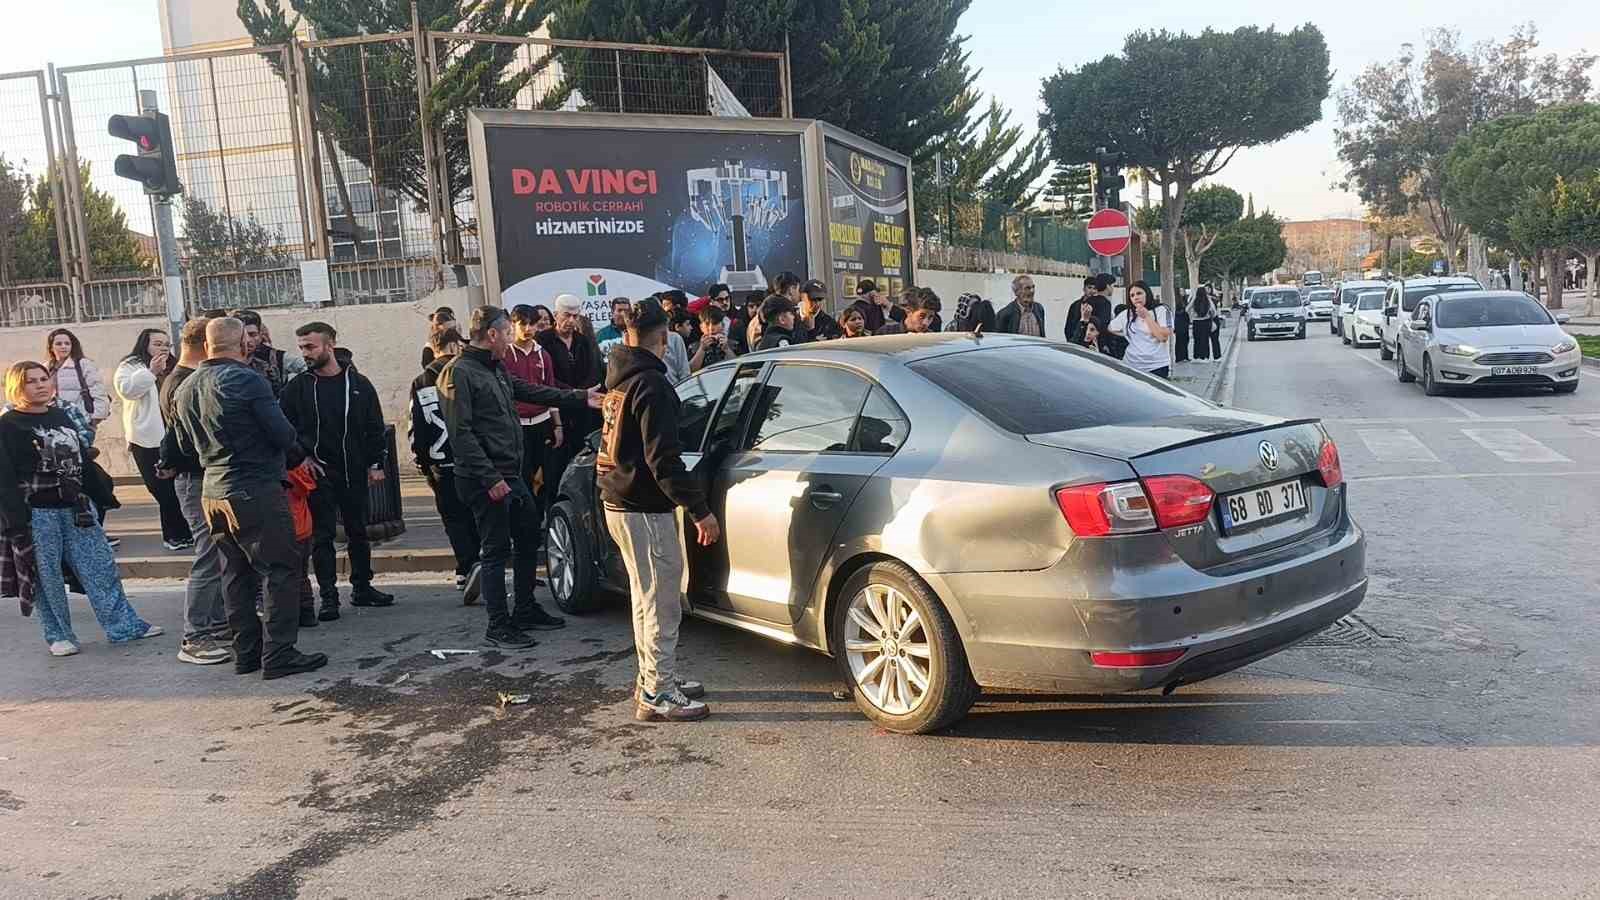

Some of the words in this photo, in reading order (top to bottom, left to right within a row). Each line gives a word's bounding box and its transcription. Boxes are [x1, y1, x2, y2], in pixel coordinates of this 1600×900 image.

[511, 168, 563, 195] DA
[566, 168, 658, 195] VINCI
[535, 199, 592, 213] ROBOTİK
[592, 199, 644, 213] CERRAHİ
[535, 217, 645, 236] HİZMETİNİZDE
[1229, 496, 1248, 522] 68
[1256, 489, 1273, 516] BD
[1281, 482, 1303, 509] 371
[1174, 525, 1203, 538] JETTA
